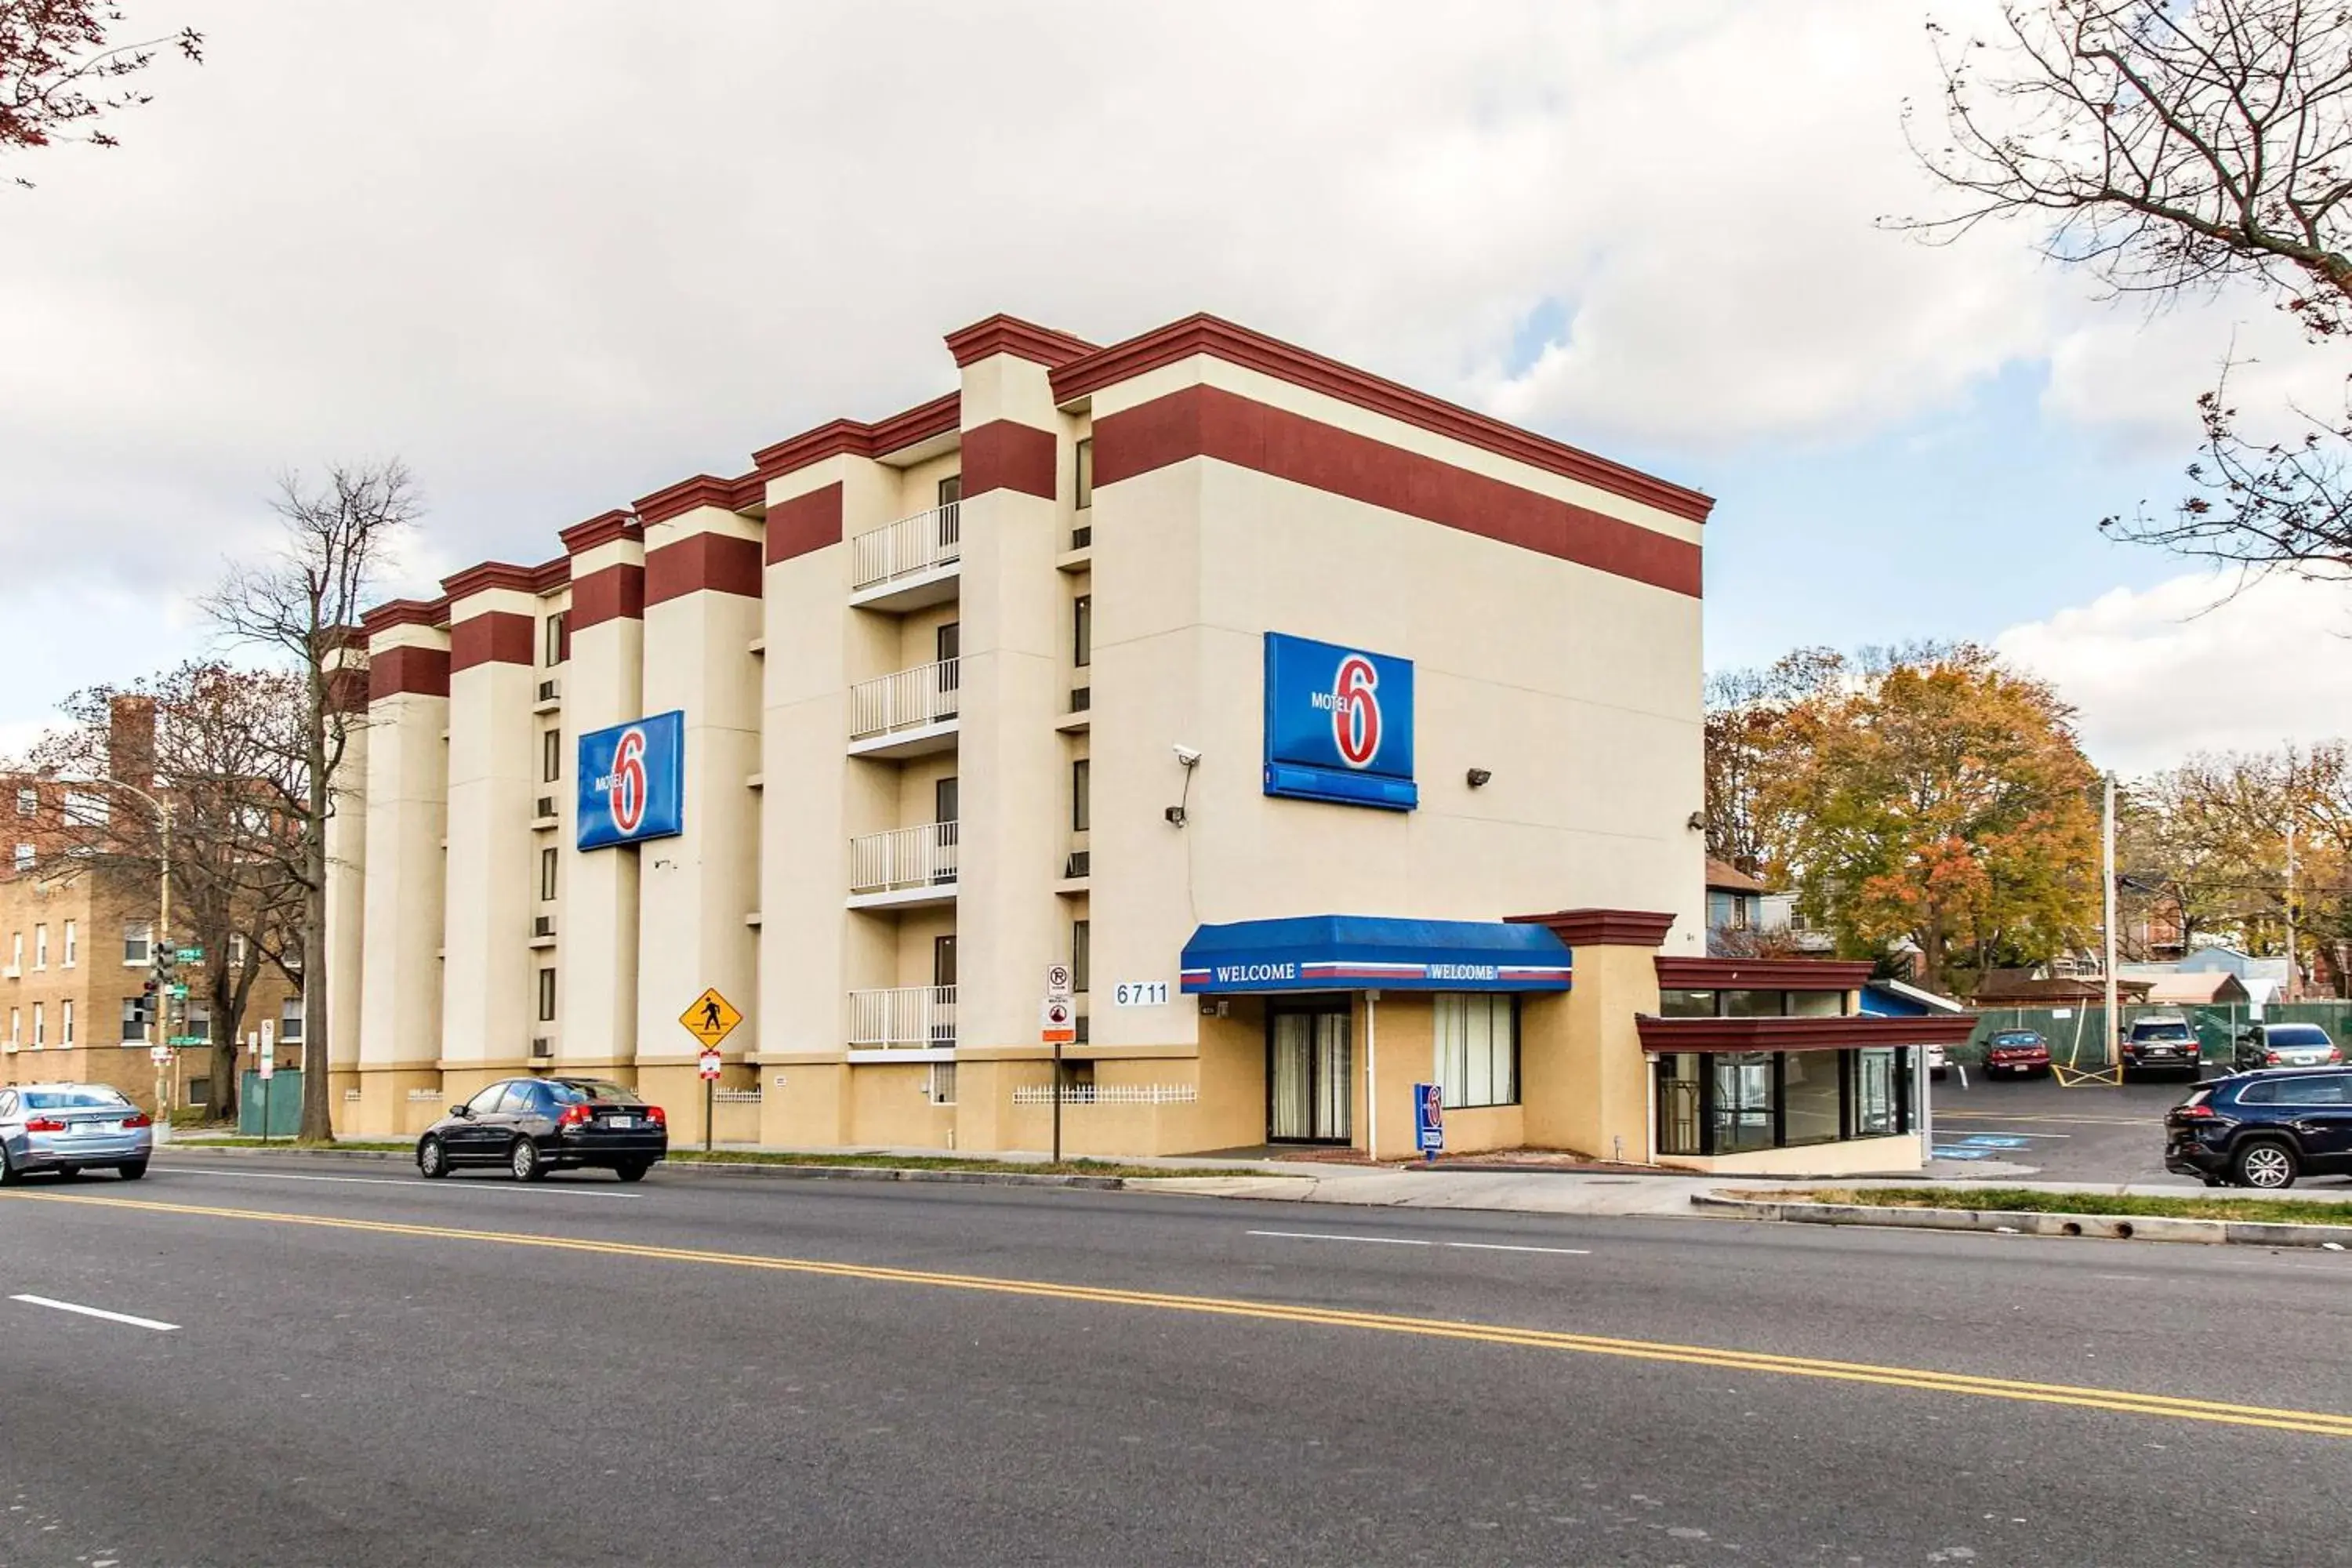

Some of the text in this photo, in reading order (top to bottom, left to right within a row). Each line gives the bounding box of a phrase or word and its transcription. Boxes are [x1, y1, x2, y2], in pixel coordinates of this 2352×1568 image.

[1312, 653, 1382, 769] MOTEL 6
[595, 726, 647, 837] MOTEL 6
[1217, 963, 1295, 982] WELCOME
[1431, 964, 1494, 980] WELCOME
[1117, 983, 1167, 1004] 6711
